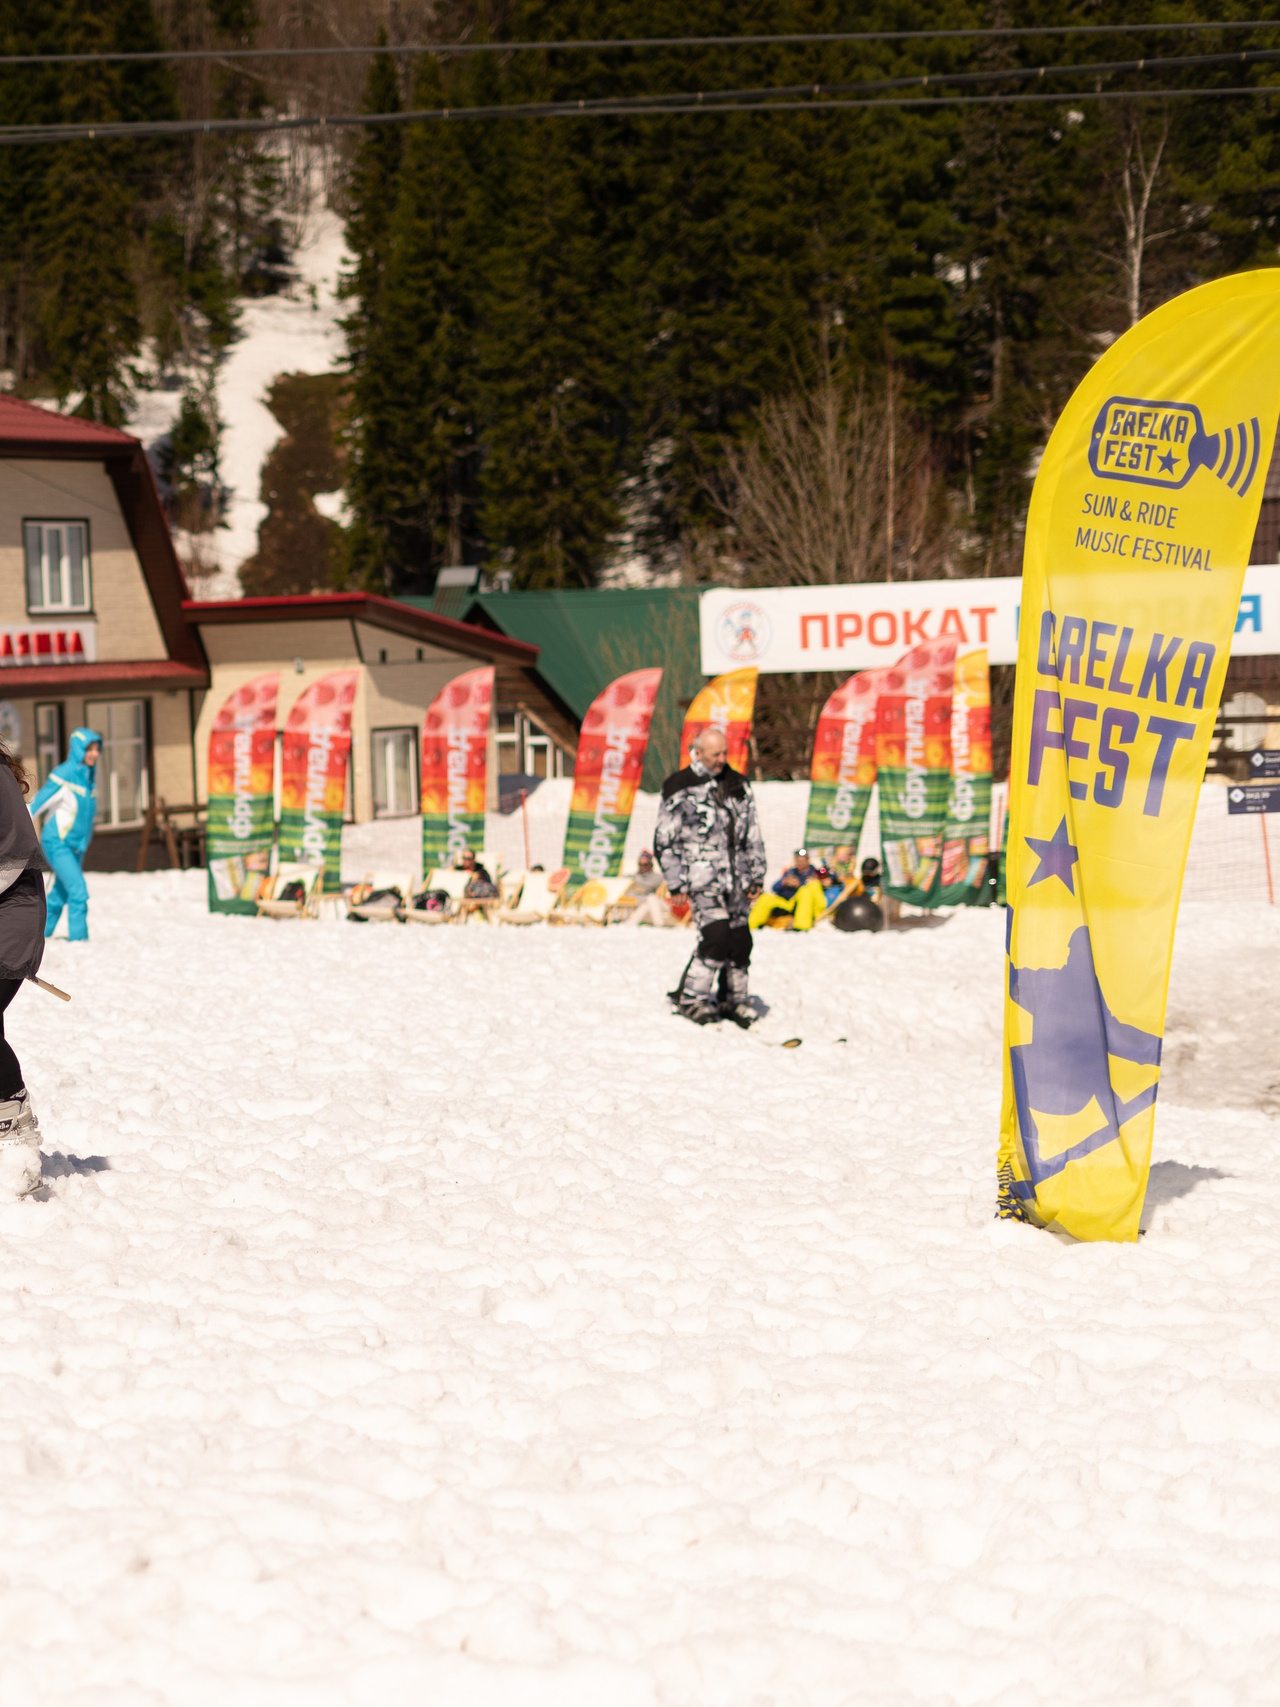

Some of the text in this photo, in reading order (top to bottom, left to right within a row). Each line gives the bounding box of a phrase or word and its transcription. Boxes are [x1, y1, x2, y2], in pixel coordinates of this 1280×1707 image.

[1109, 409, 1189, 444] GRELKA
[1103, 440, 1158, 471] FEST
[1081, 493, 1179, 529] SUN & RIDE
[1075, 526, 1213, 572] MUSIC FESTIVAL
[800, 607, 997, 649] ПРОКАТ
[1037, 610, 1216, 710] GRELKA
[1027, 689, 1197, 818] FEST
